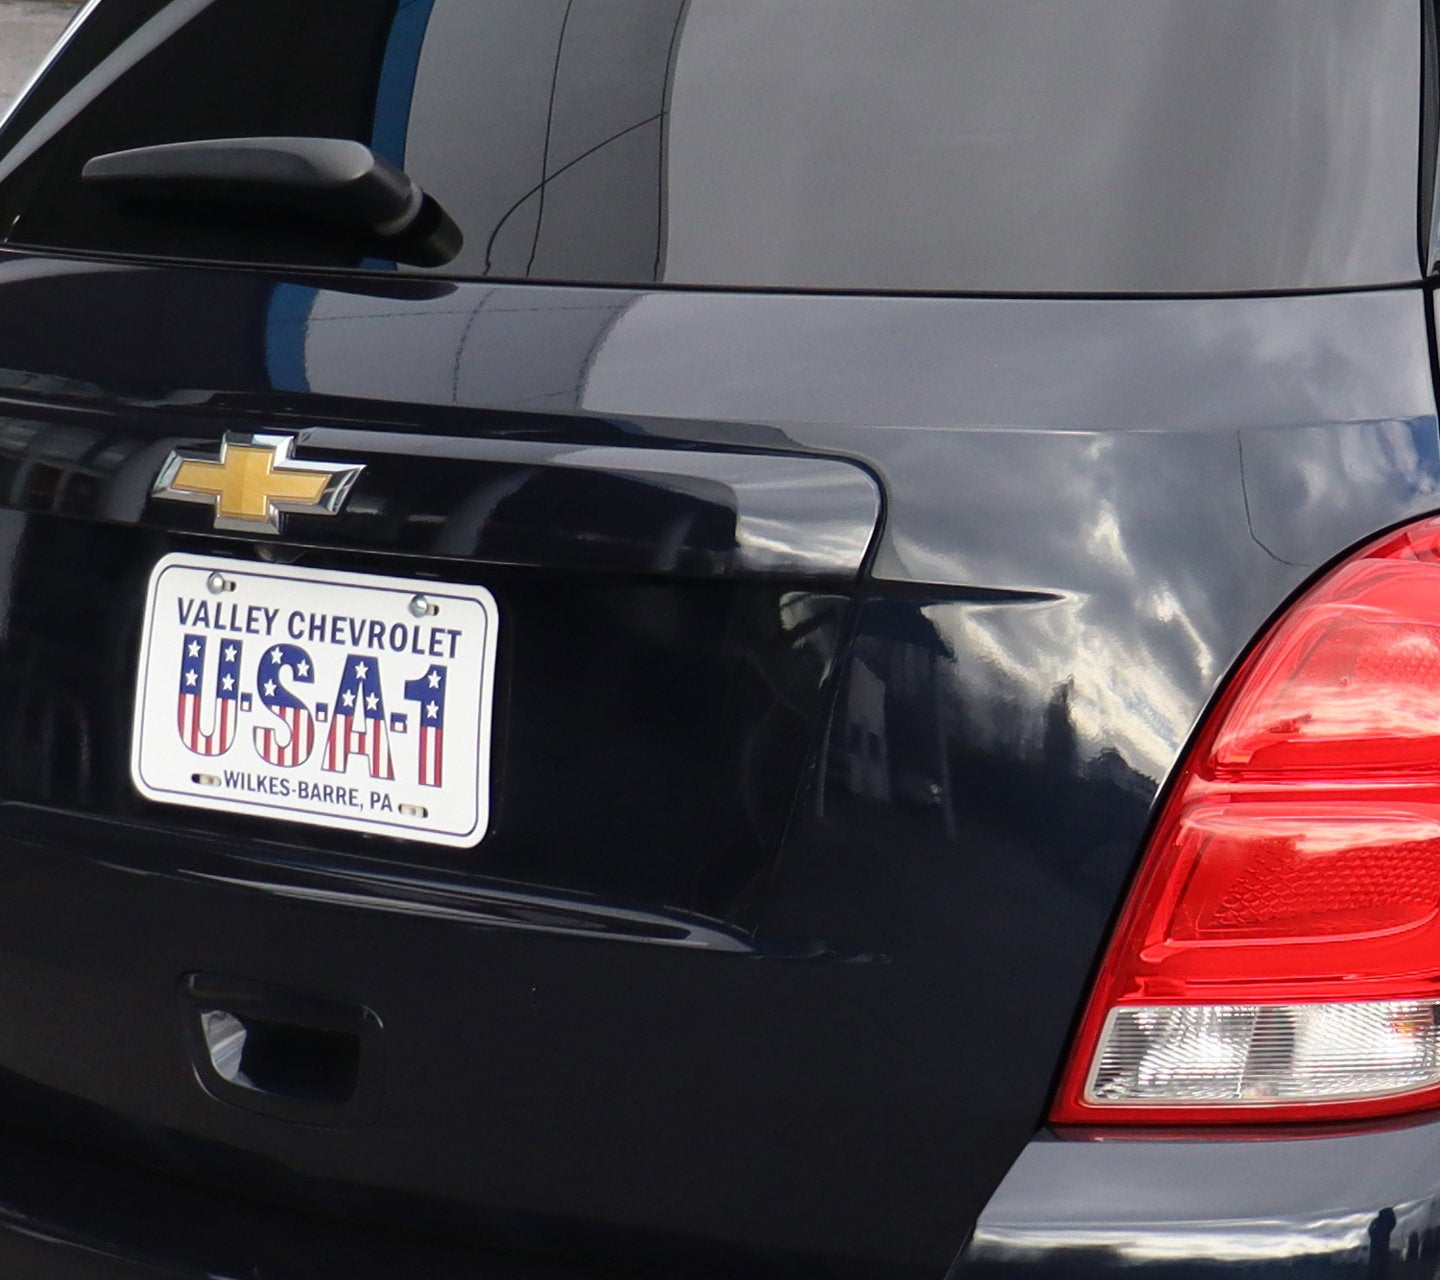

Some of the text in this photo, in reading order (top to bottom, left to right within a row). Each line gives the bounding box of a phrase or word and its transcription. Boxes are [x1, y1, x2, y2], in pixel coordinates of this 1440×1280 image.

[177, 597, 463, 659] VALLEY CHEVROLET
[222, 769, 393, 813] WILKES-BARRE, PA
